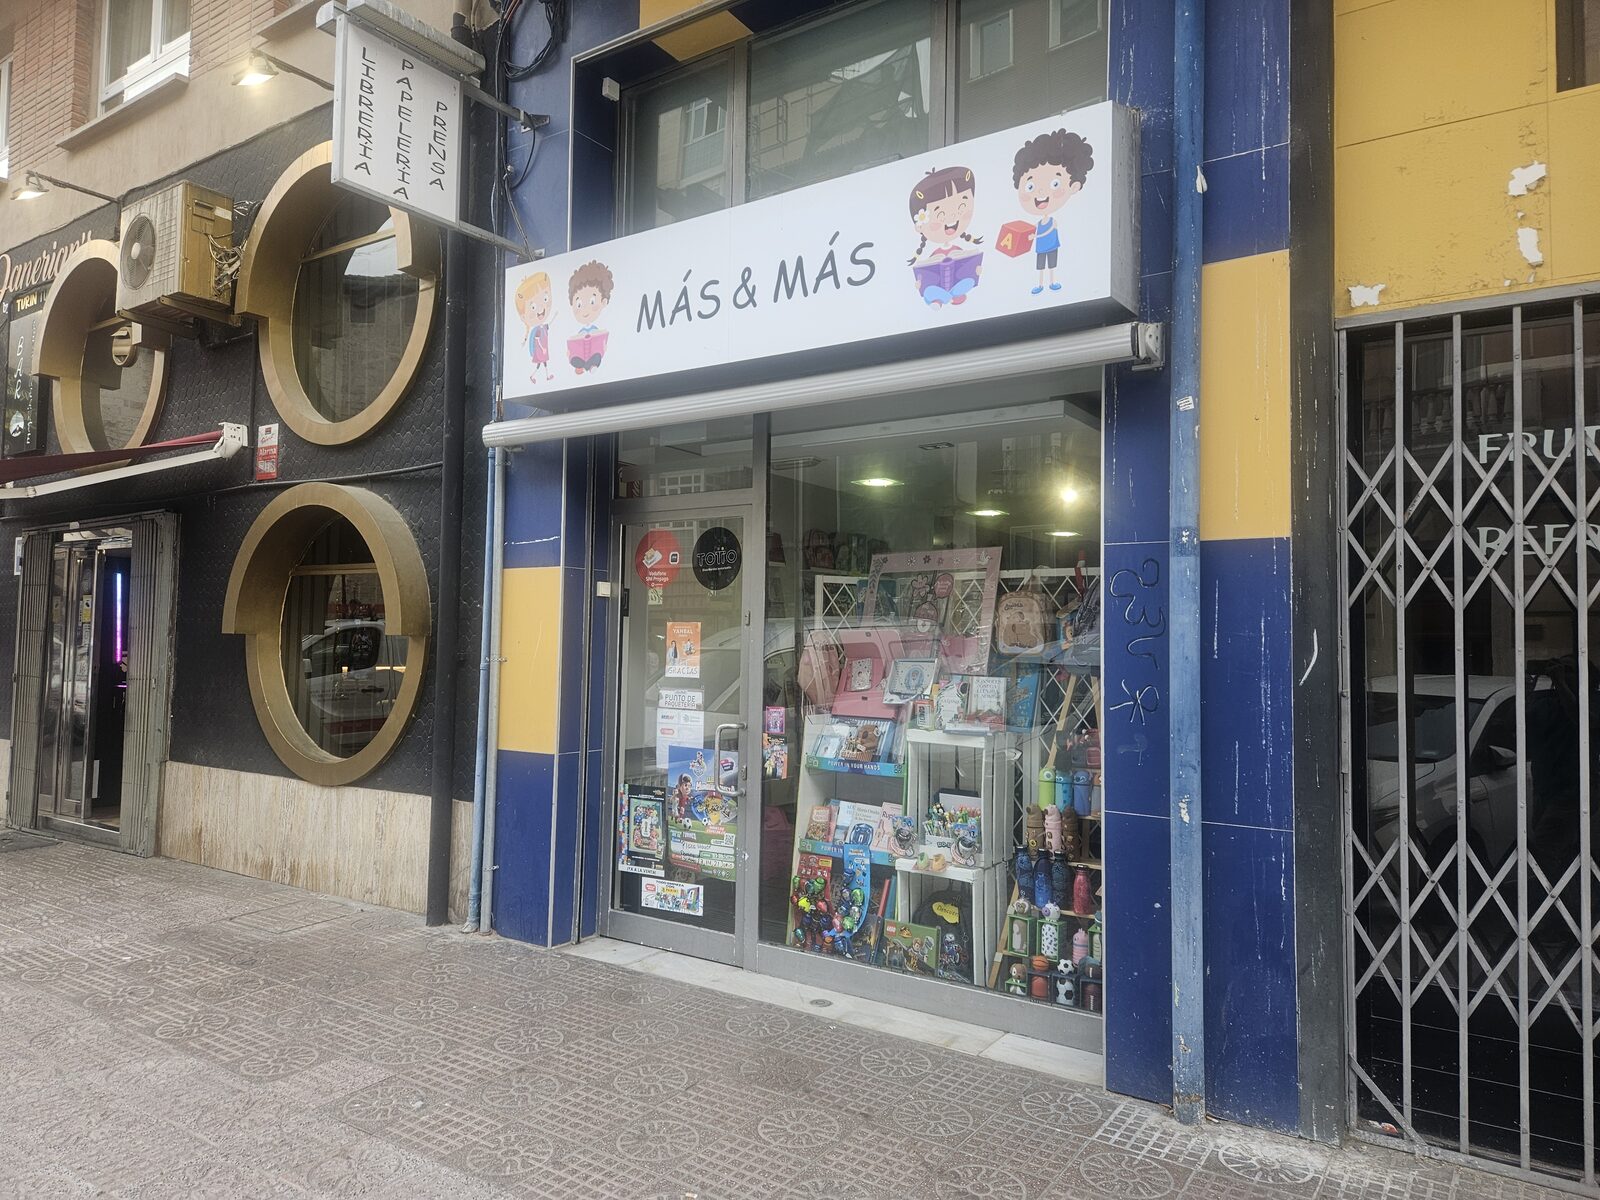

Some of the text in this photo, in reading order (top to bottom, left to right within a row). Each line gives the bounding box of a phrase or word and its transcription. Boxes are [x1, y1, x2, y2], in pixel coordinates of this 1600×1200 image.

[354, 46, 376, 176] LIBRERÍA
[393, 58, 414, 200] PAPELERÍA
[428, 100, 448, 191] PRENSA
[1000, 232, 1014, 250] A
[16, 292, 38, 312] TURIN
[636, 230, 876, 333] MÁS & MÁS
[14, 336, 25, 400] BAR
[664, 693, 696, 703] PUNTO DE
[827, 760, 844, 768] POWER
[864, 763, 881, 771] HANDS
